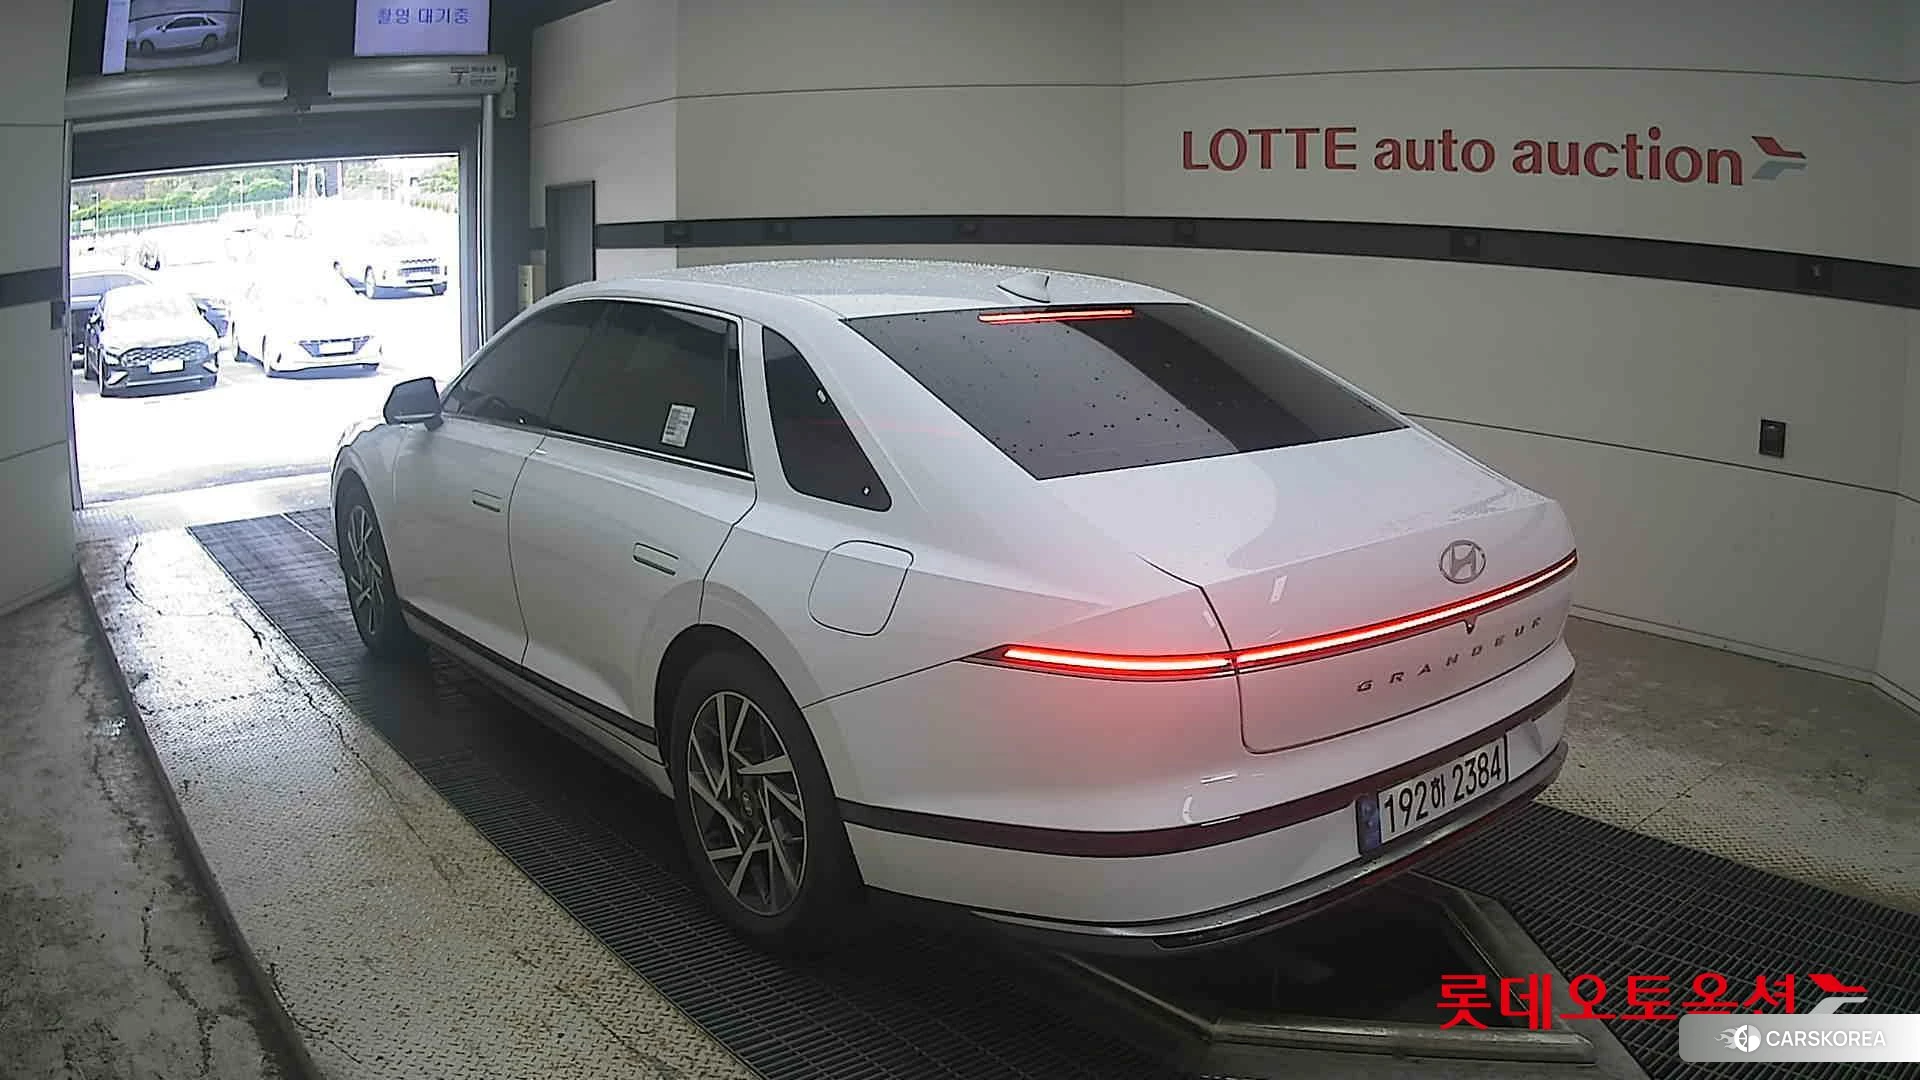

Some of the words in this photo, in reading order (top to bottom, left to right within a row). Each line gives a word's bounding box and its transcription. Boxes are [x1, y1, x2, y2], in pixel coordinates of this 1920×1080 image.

[418, 8, 470, 24] 대기중
[1182, 127, 1357, 171] LOTTE
[1374, 129, 1495, 172] auto
[1512, 126, 1743, 186] auction
[1356, 616, 1541, 692] GRANDEUR
[1384, 773, 1446, 833] 192하
[1452, 745, 1502, 803] 2384
